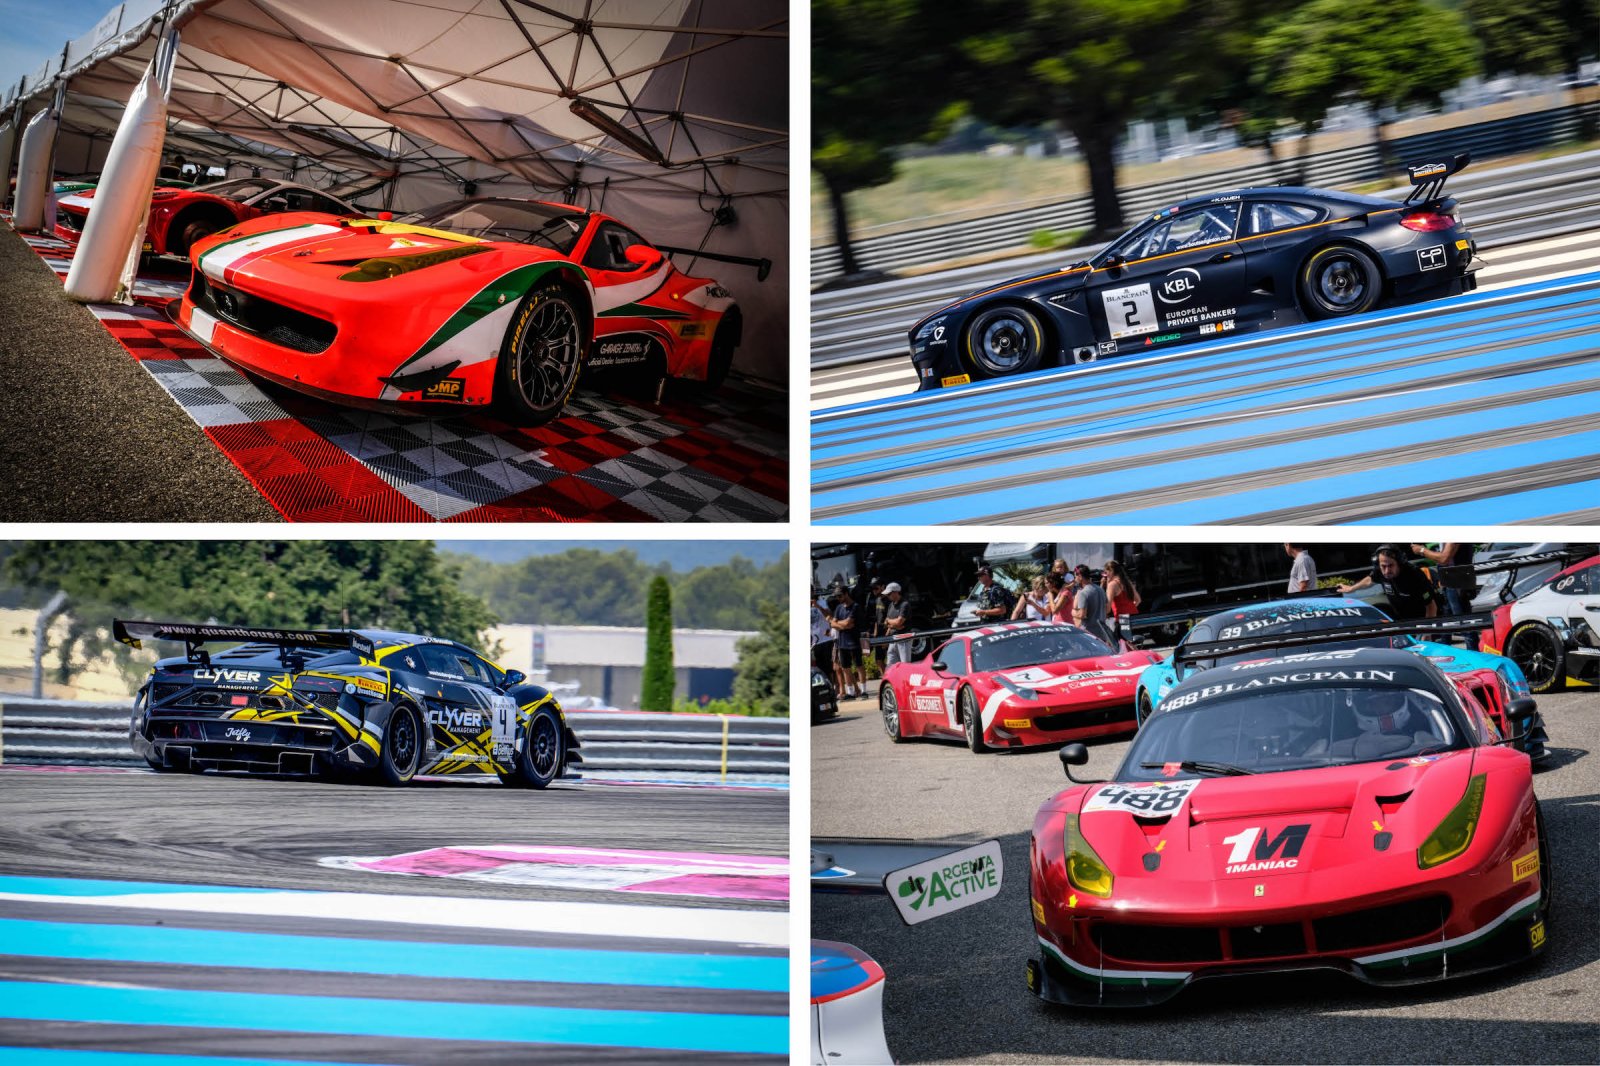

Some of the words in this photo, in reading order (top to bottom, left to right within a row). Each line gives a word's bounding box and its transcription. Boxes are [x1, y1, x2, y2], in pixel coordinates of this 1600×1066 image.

[1106, 288, 1149, 303] BLANCPAIN
[1163, 277, 1195, 295] KBL
[1122, 300, 1141, 327] 2
[1165, 306, 1208, 320] EUROPEAN
[1167, 315, 1199, 328] PRIVATE
[1200, 307, 1237, 321] BANKERS
[511, 296, 538, 353] PIRELLI
[159, 625, 317, 642] www.quanthouse.com
[988, 625, 1072, 643] BLANCPAIN
[1221, 626, 1243, 640] 39
[1244, 607, 1363, 633] BLANCPAIN
[193, 667, 261, 684] CLYVER
[1159, 691, 1199, 713] 488
[1200, 669, 1397, 699] BLANCPAIN
[429, 705, 482, 731] CLYVER
[500, 709, 507, 736] 4
[225, 727, 251, 742] Jetfly
[1098, 788, 1190, 812] 488
[1222, 823, 1312, 865] 1M
[1225, 859, 1299, 875] 1MANIAC
[928, 868, 998, 907] ACTIVE
